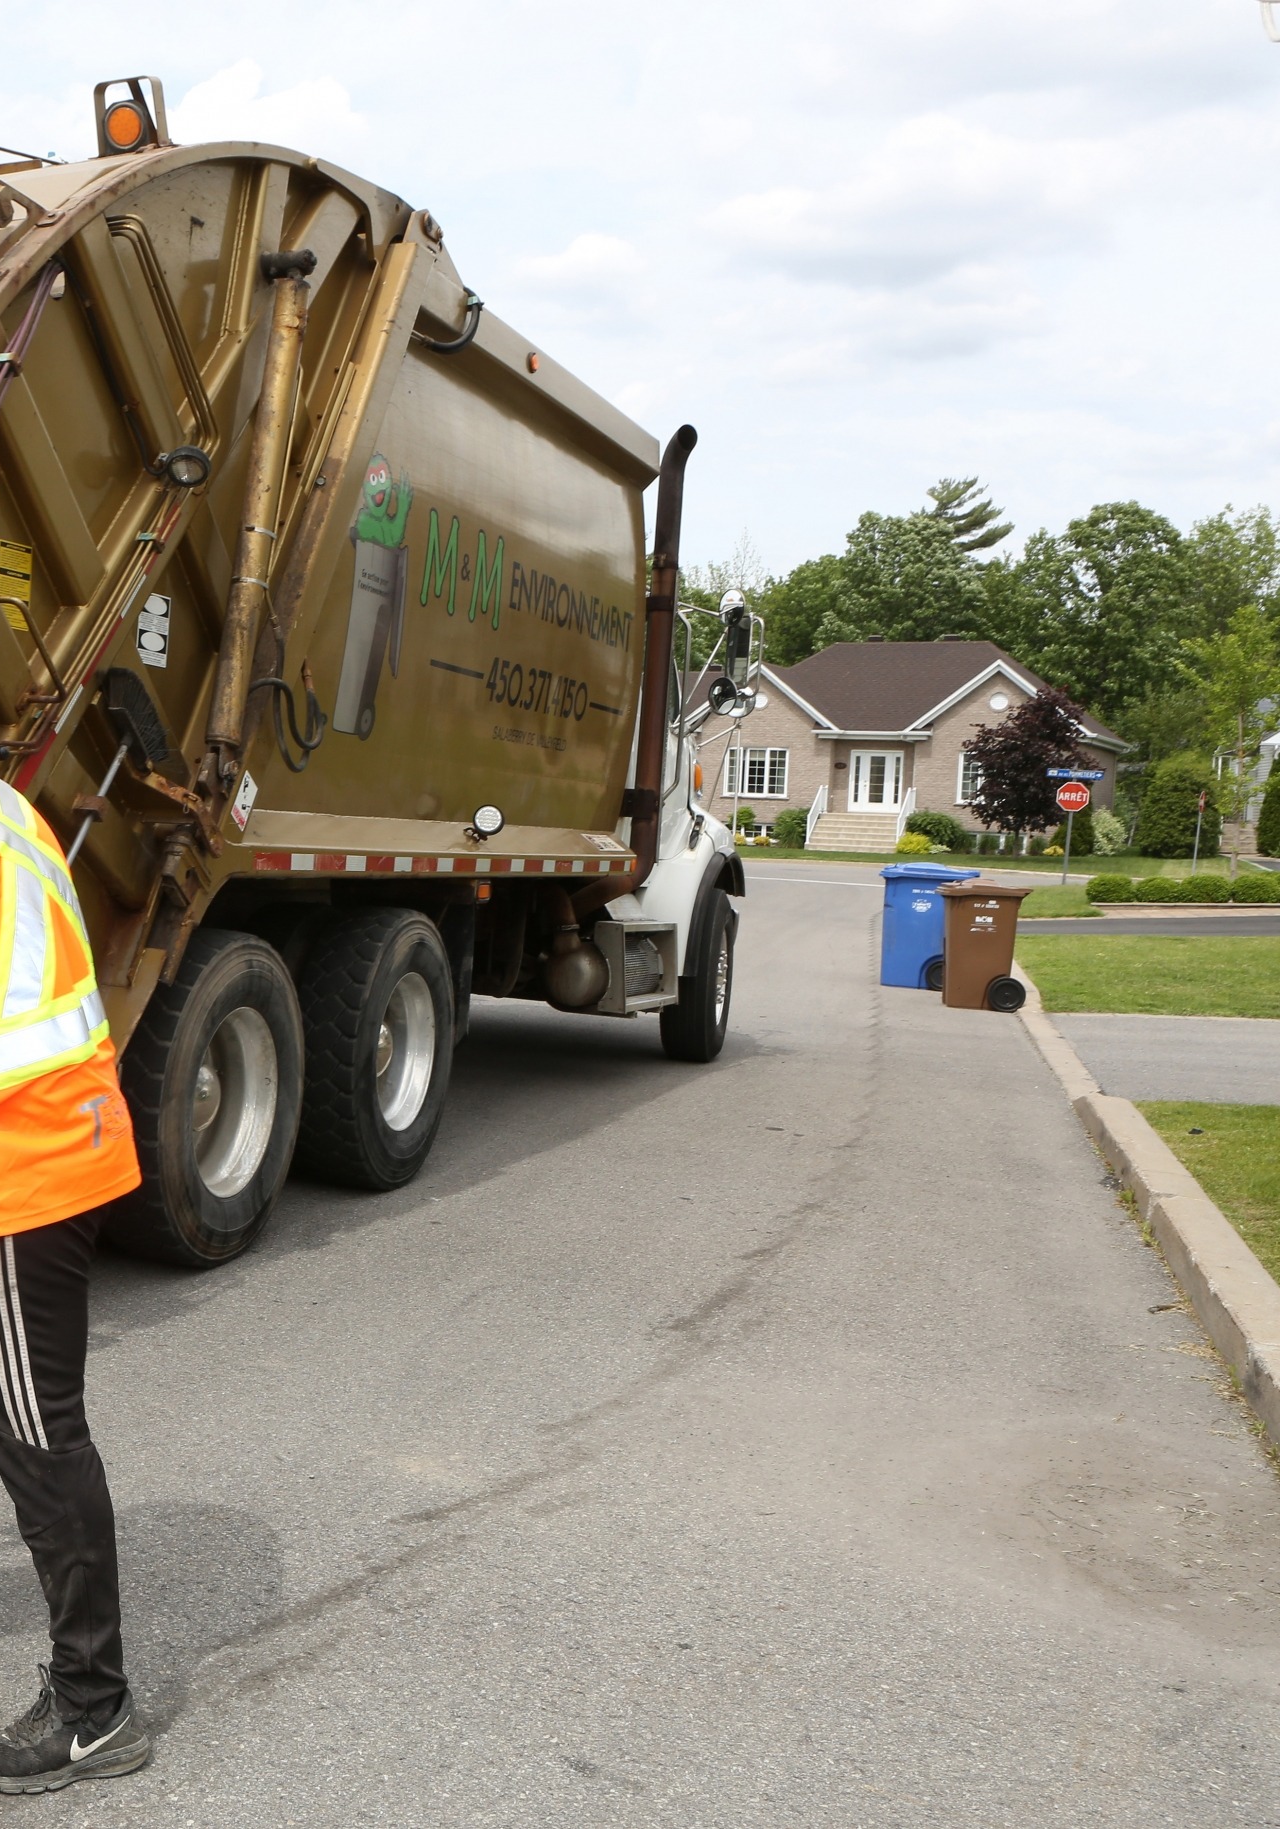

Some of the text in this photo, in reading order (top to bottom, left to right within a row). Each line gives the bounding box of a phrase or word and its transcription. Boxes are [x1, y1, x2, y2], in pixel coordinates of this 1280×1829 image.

[421, 508, 634, 653] M & M ENVIRONNEMENT
[486, 657, 588, 721] 450.371.4150
[1058, 791, 1088, 802] ARRÊT
